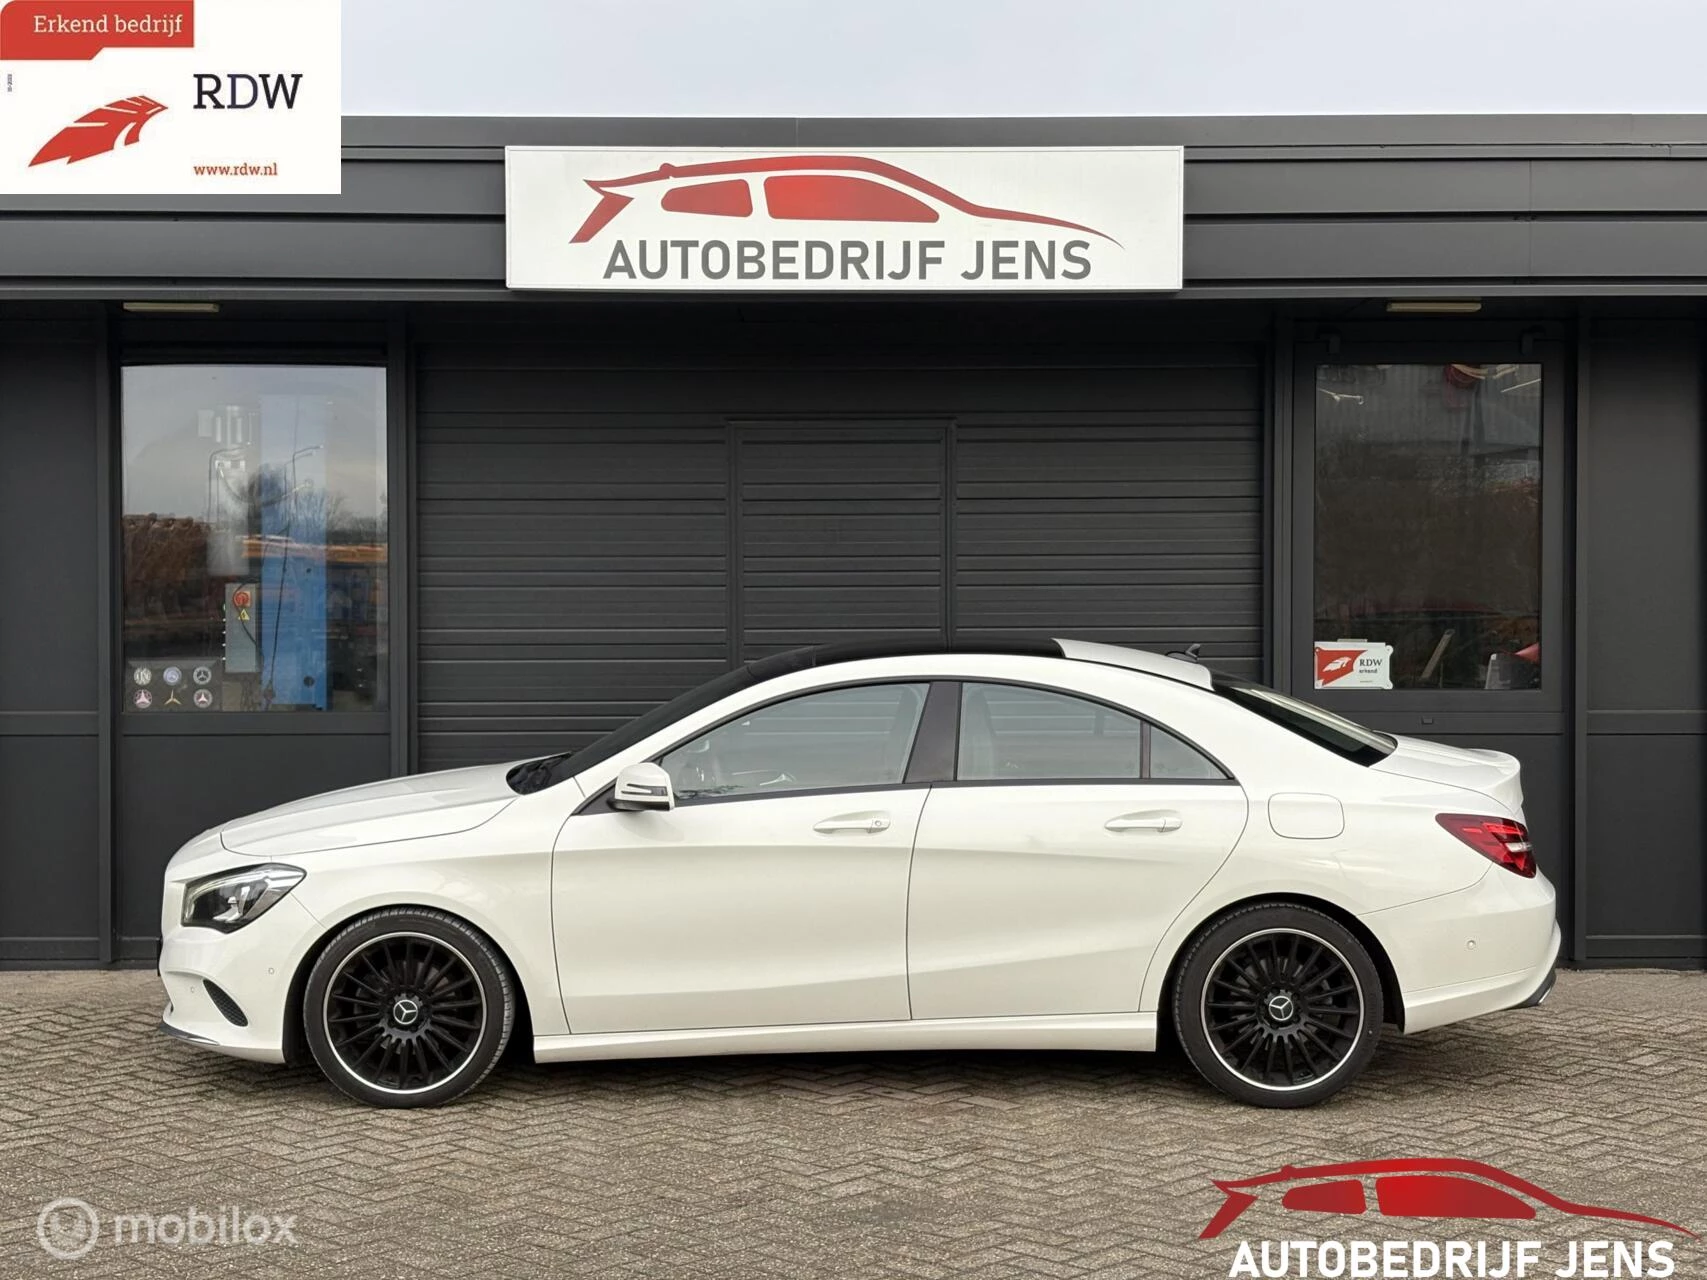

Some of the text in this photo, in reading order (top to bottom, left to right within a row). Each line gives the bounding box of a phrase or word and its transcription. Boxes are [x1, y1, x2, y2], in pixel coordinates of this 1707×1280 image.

[603, 239, 1091, 281] AUTOBEDRIJF JENS
[1359, 658, 1383, 667] RDW
